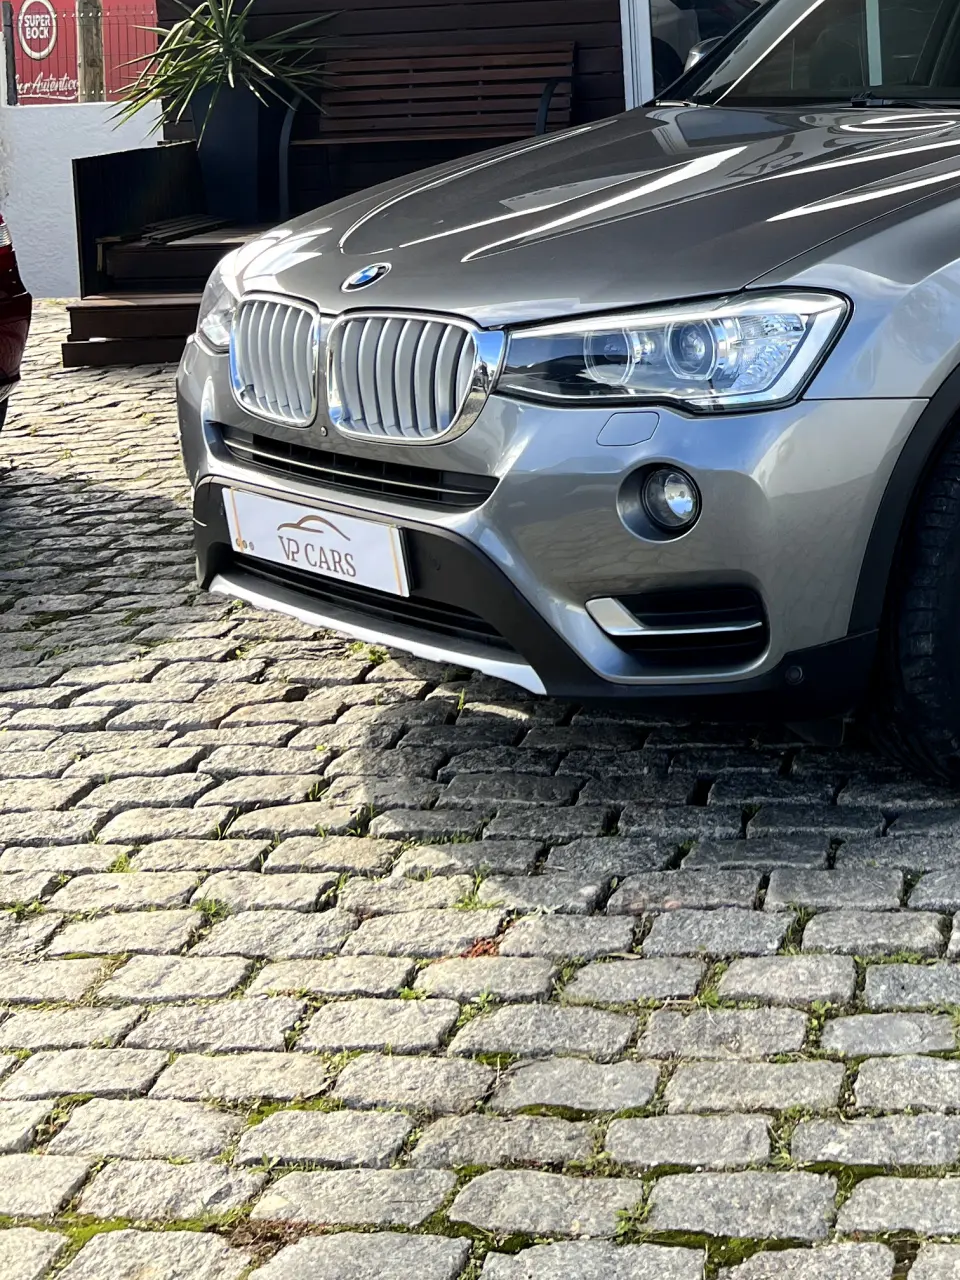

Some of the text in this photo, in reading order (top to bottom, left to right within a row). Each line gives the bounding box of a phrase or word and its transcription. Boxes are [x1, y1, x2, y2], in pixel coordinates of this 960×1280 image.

[24, 14, 51, 28] SUPER
[25, 27, 50, 40] BOCK
[277, 535, 357, 578] VP CARS
